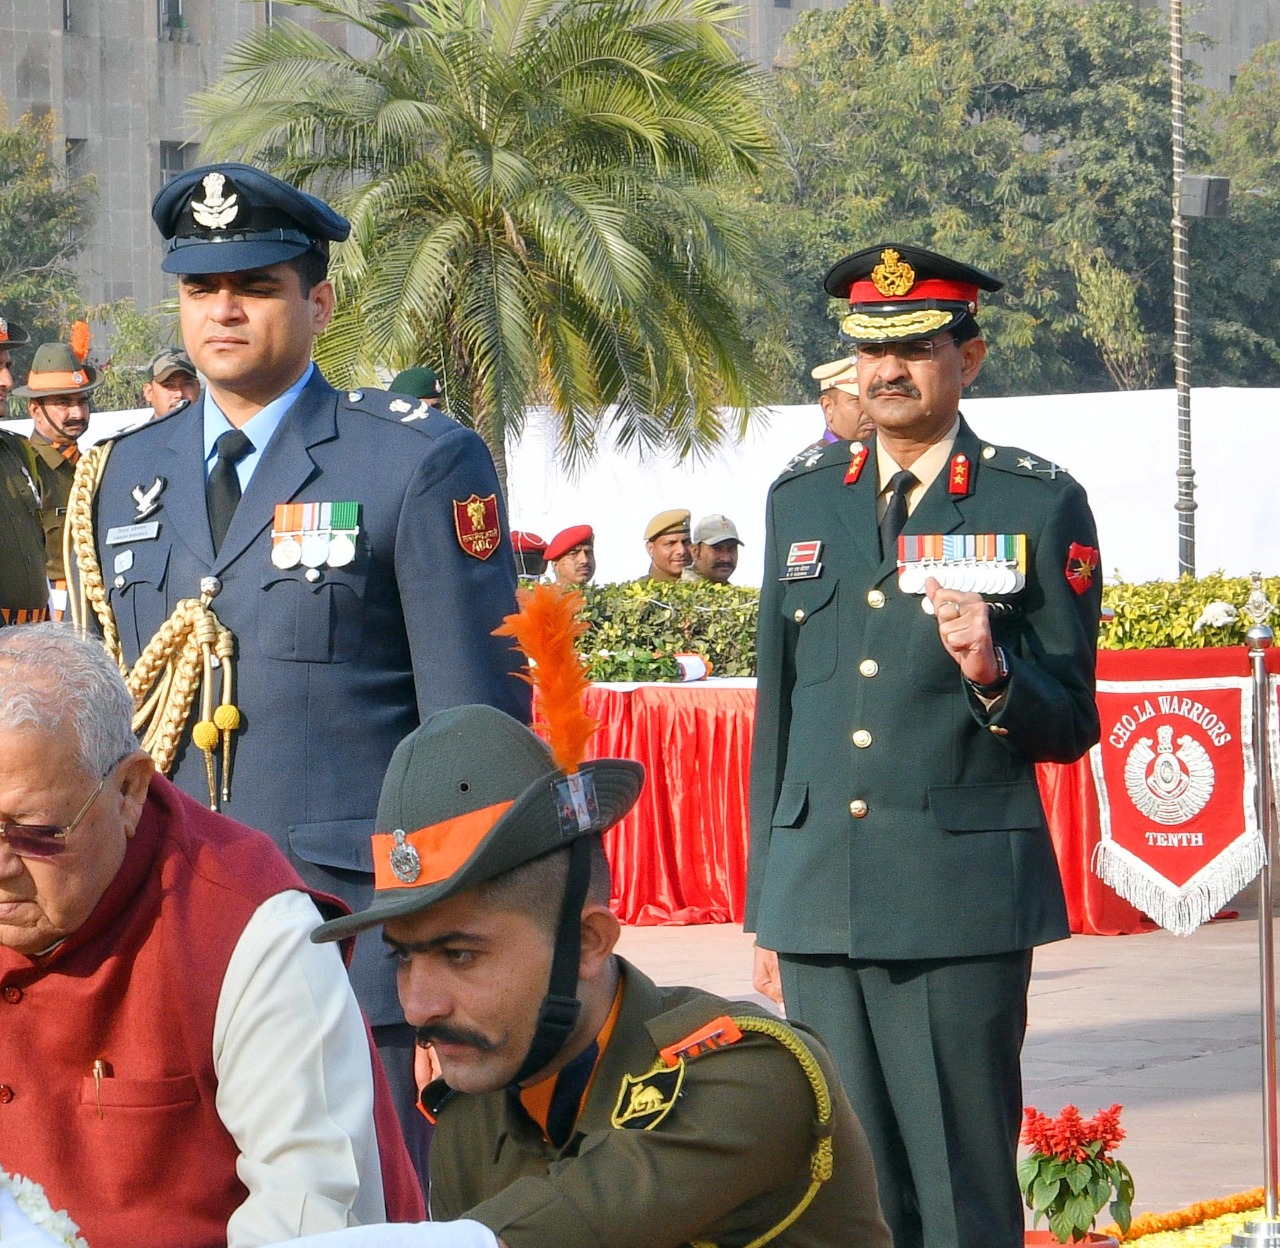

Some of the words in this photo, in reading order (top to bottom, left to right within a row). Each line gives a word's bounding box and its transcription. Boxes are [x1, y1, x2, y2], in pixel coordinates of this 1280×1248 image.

[472, 538, 493, 552] ADC
[1108, 713, 1137, 750] CHO
[1133, 700, 1155, 723] LA
[1158, 695, 1232, 747] WARRIORS
[1144, 832, 1204, 847] TENTH
